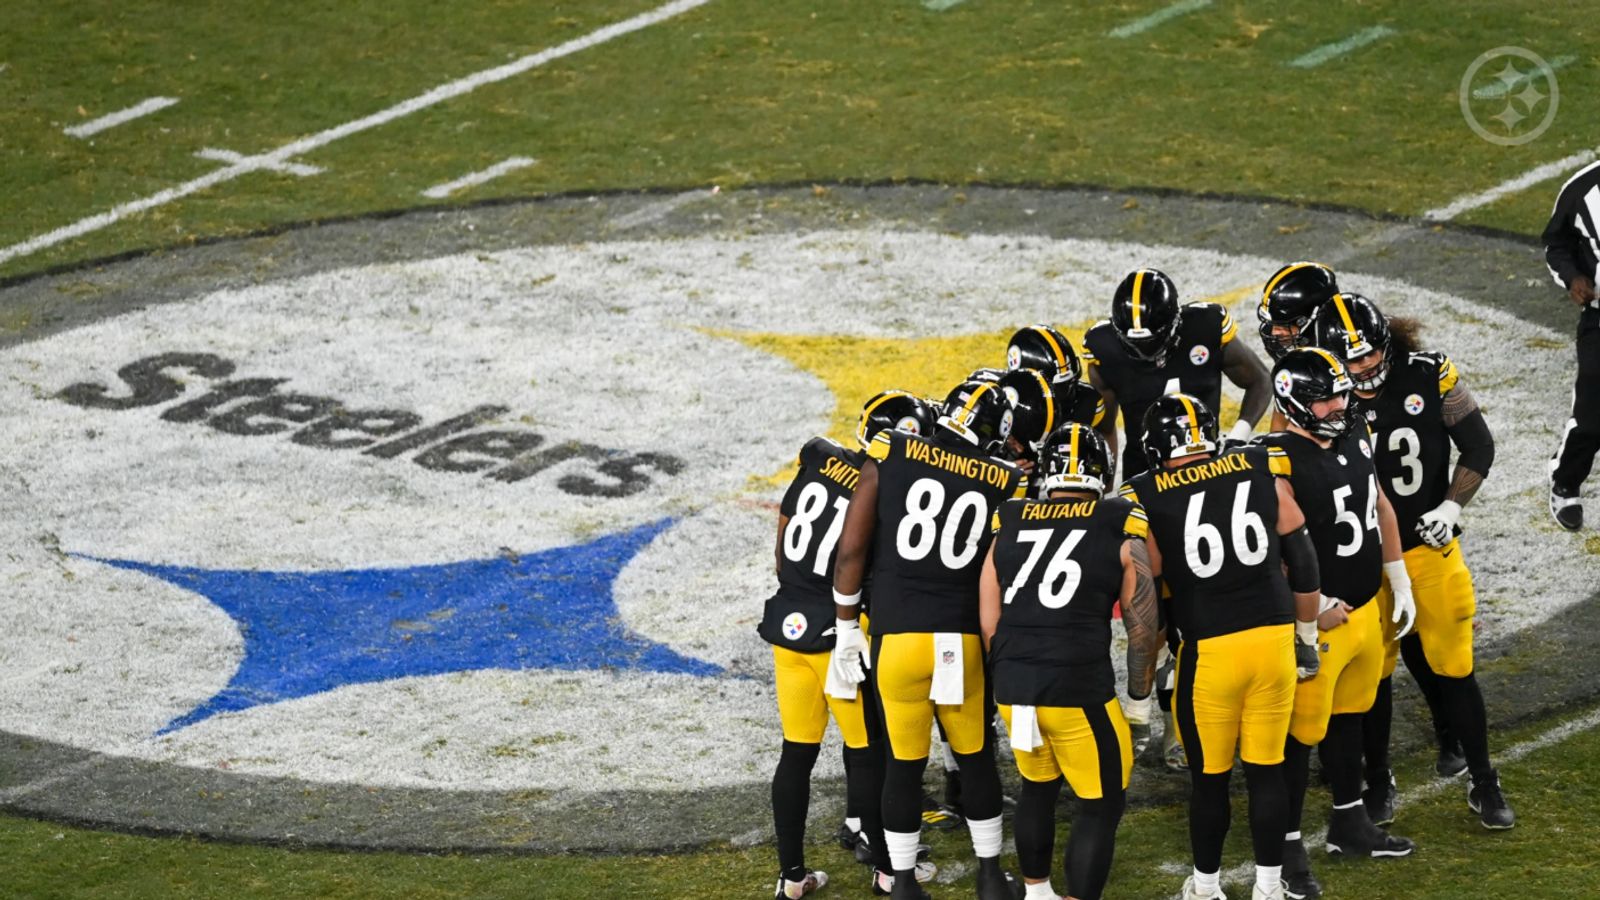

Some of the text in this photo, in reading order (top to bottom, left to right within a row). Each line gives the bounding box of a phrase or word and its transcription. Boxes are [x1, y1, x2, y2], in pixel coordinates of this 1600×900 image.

[53, 351, 686, 498] Steelers
[905, 438, 1010, 490] WASHINGTON
[1369, 427, 1423, 496] 3
[1062, 459, 1085, 475] 76
[1155, 452, 1252, 493] McCORMICK
[784, 482, 850, 576] 81
[896, 478, 988, 569] 80
[1021, 500, 1097, 520] FAUTANU
[1184, 480, 1269, 578] 66
[1332, 473, 1382, 556] 54
[1003, 529, 1087, 609] 76
